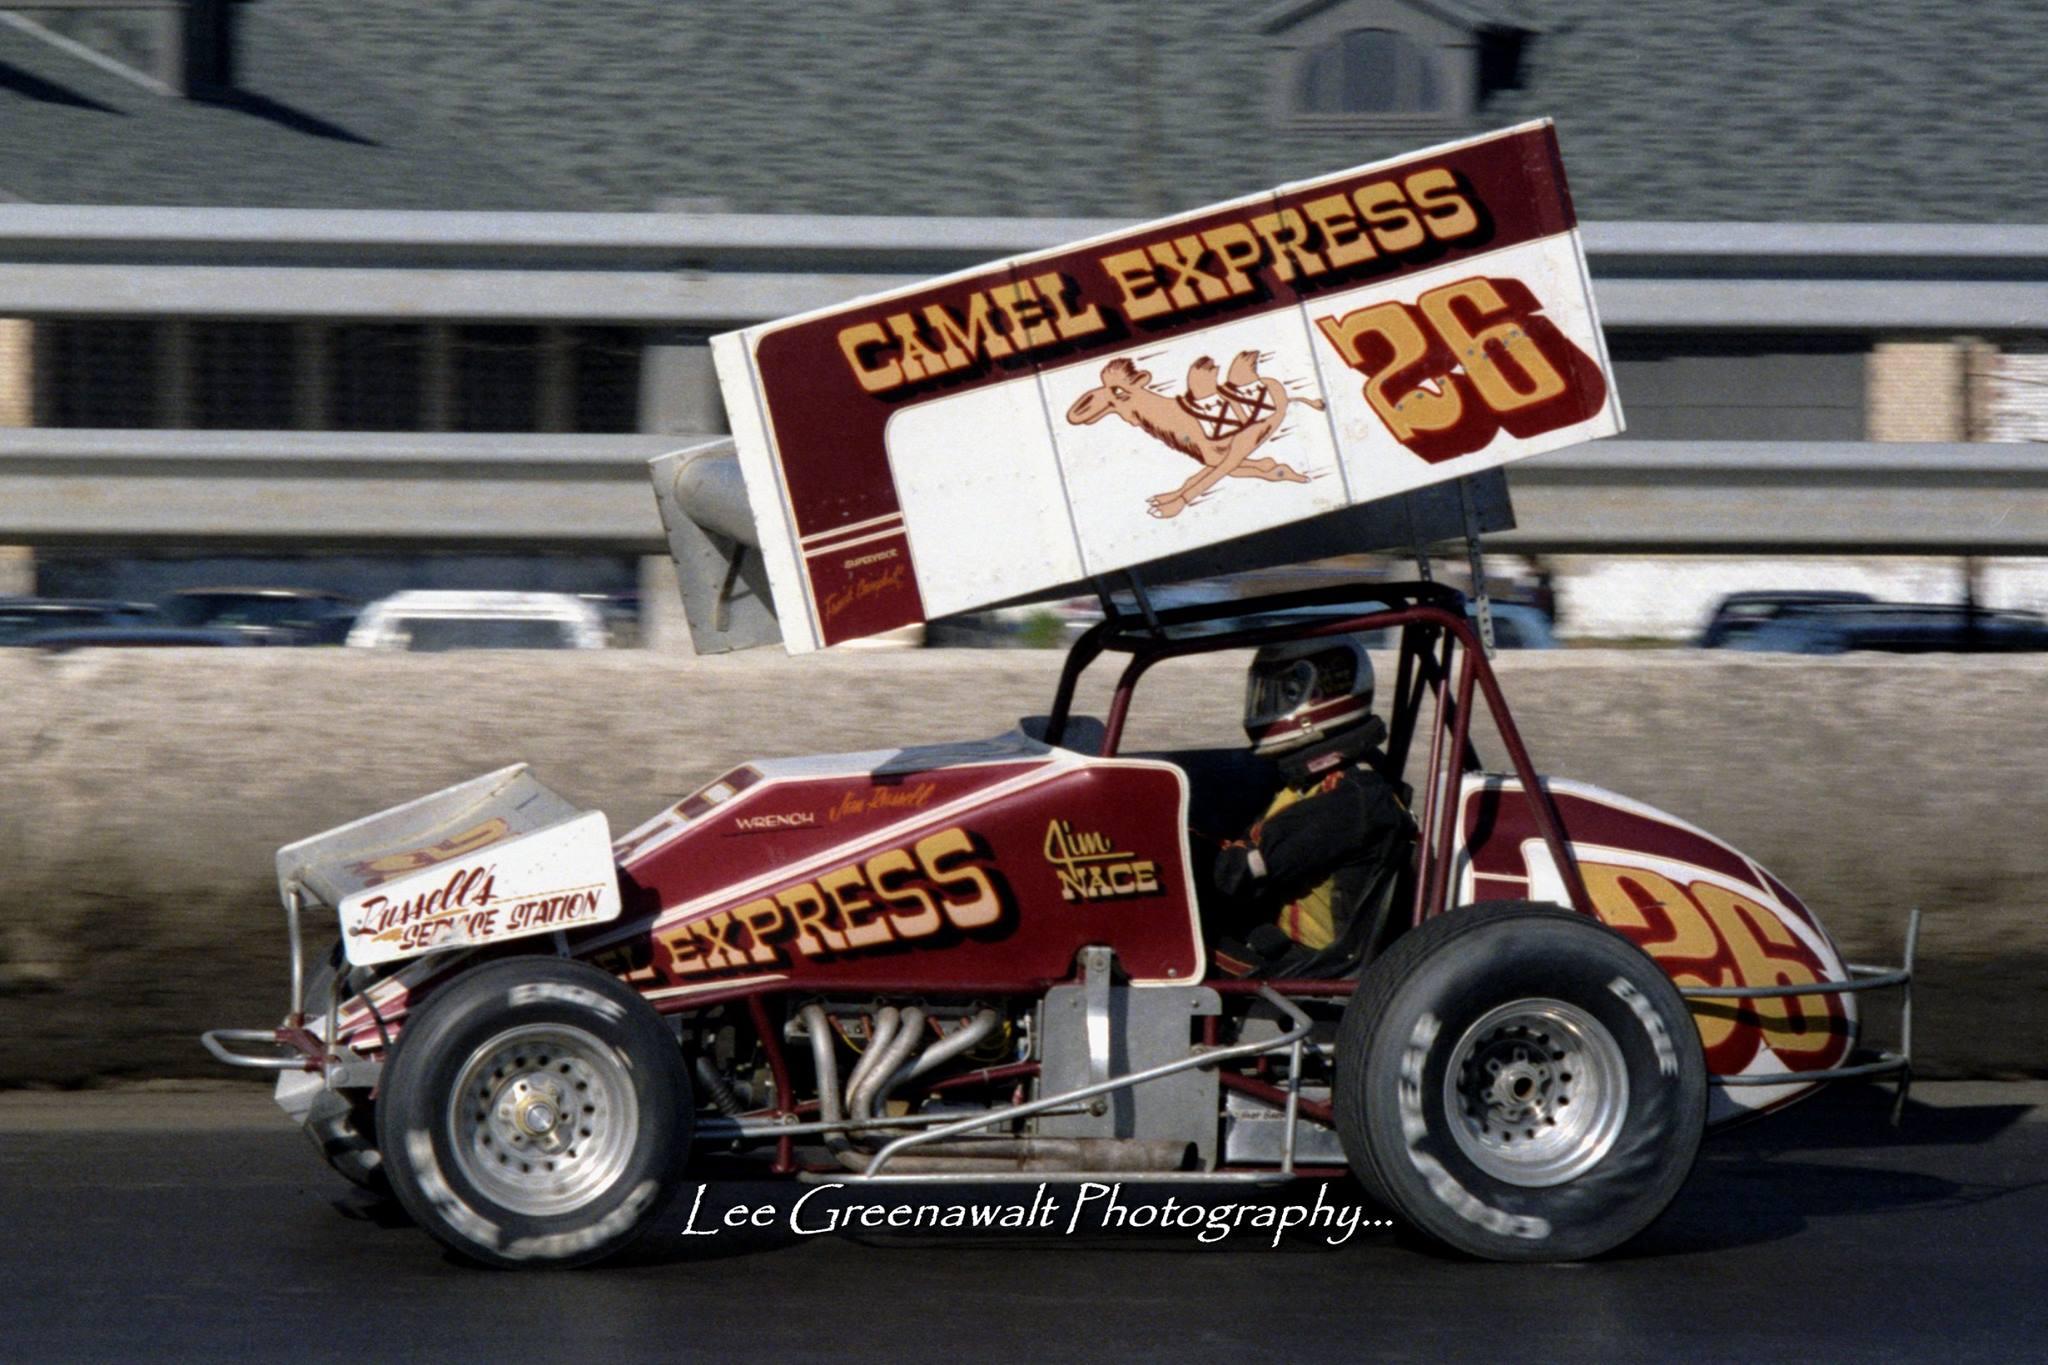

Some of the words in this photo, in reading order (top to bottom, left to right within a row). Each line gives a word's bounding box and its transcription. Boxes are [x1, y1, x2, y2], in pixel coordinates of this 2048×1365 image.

[837, 272, 1107, 396] CAMEL
[1101, 167, 1481, 324] EXPRESS
[1316, 276, 1578, 448] 26
[736, 812, 815, 829] WRENCH
[1044, 819, 1134, 881] Jim
[354, 864, 499, 937] Russell's
[506, 889, 602, 929] STATION
[659, 826, 1002, 976] EXPRESS
[1056, 861, 1159, 900] NACE
[1573, 861, 1831, 1062] 26
